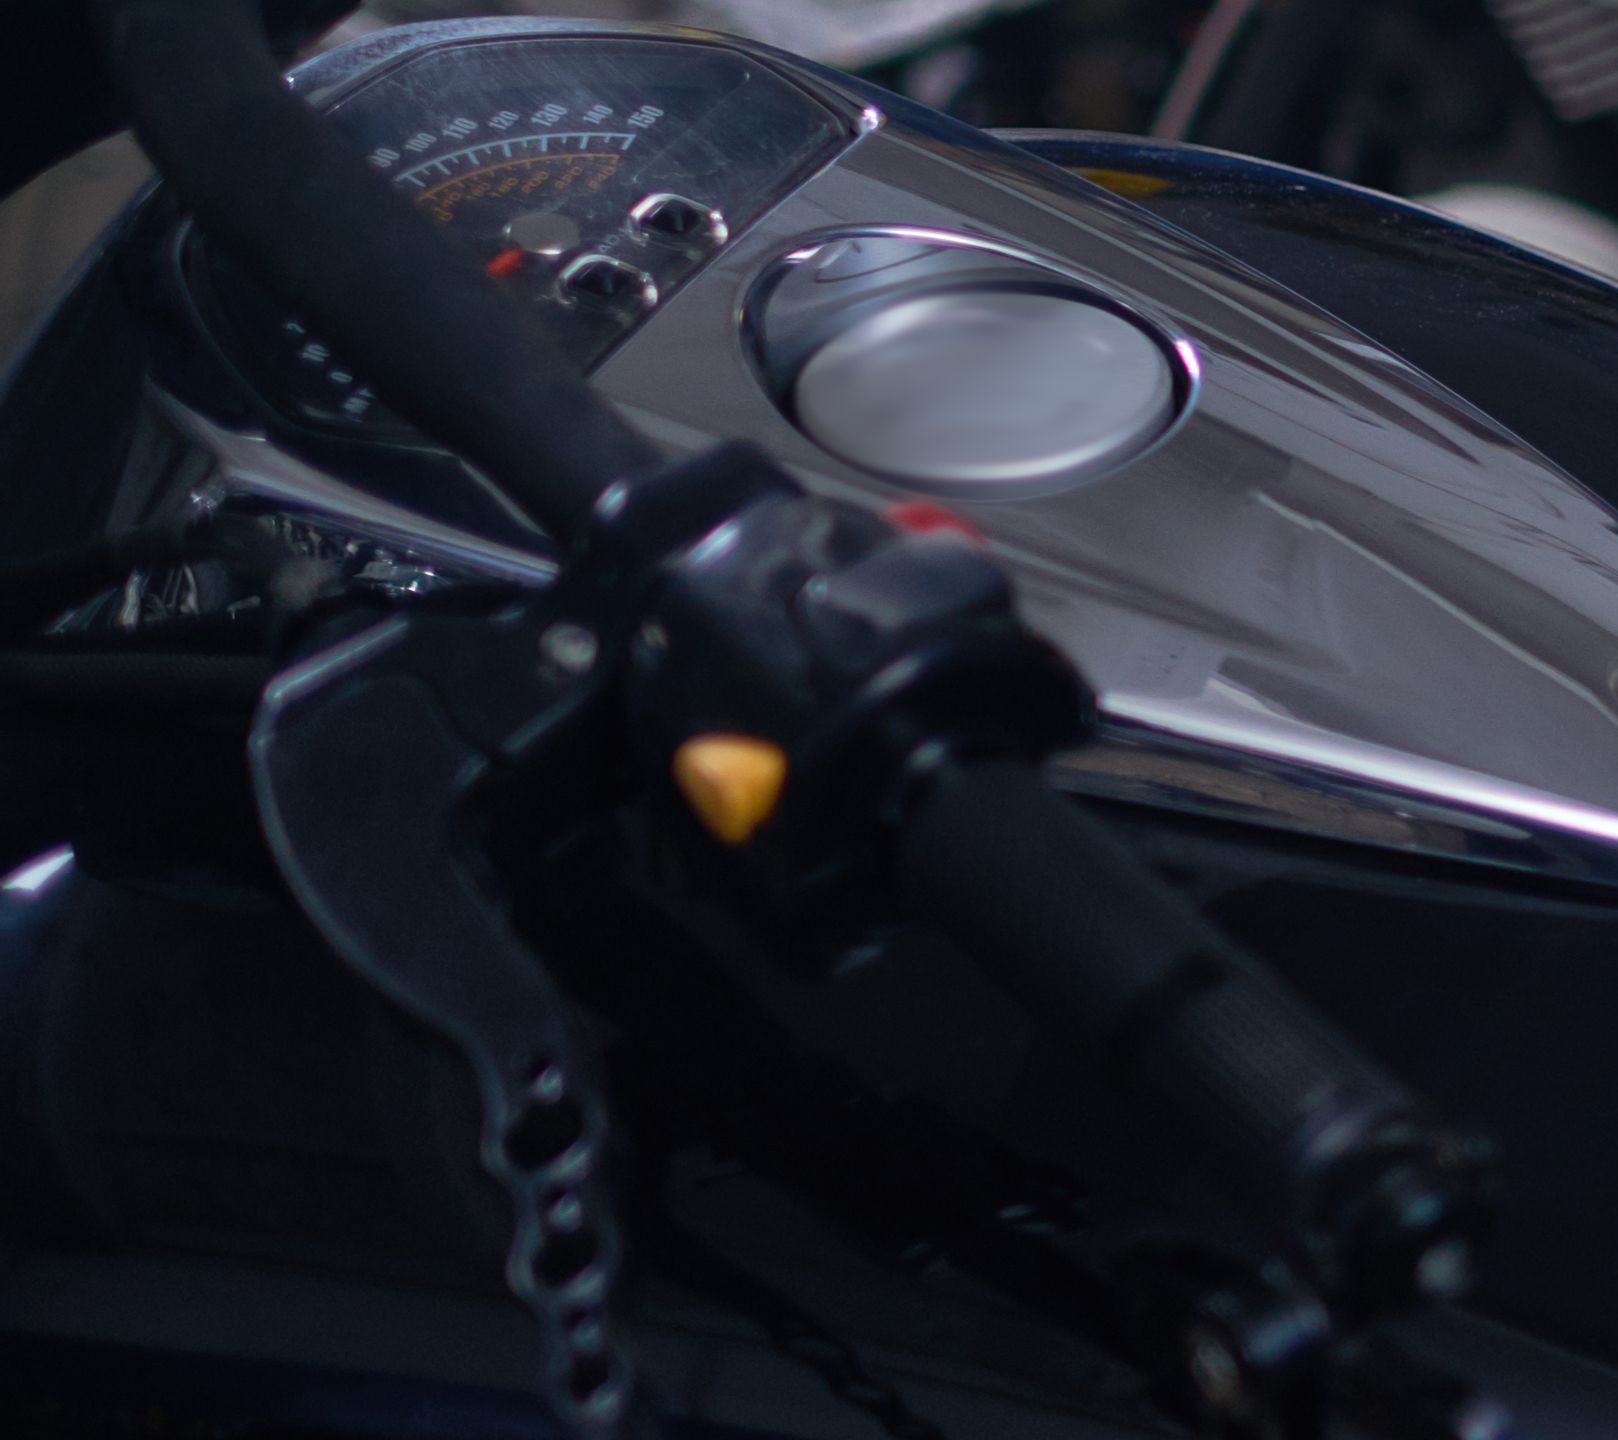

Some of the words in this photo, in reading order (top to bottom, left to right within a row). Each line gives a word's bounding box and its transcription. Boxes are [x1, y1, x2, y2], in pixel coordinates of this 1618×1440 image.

[403, 131, 438, 153] 100
[441, 117, 480, 140] 110
[487, 110, 520, 131] 120
[531, 103, 570, 127] 130
[582, 104, 615, 125] 140
[626, 105, 665, 130] 150
